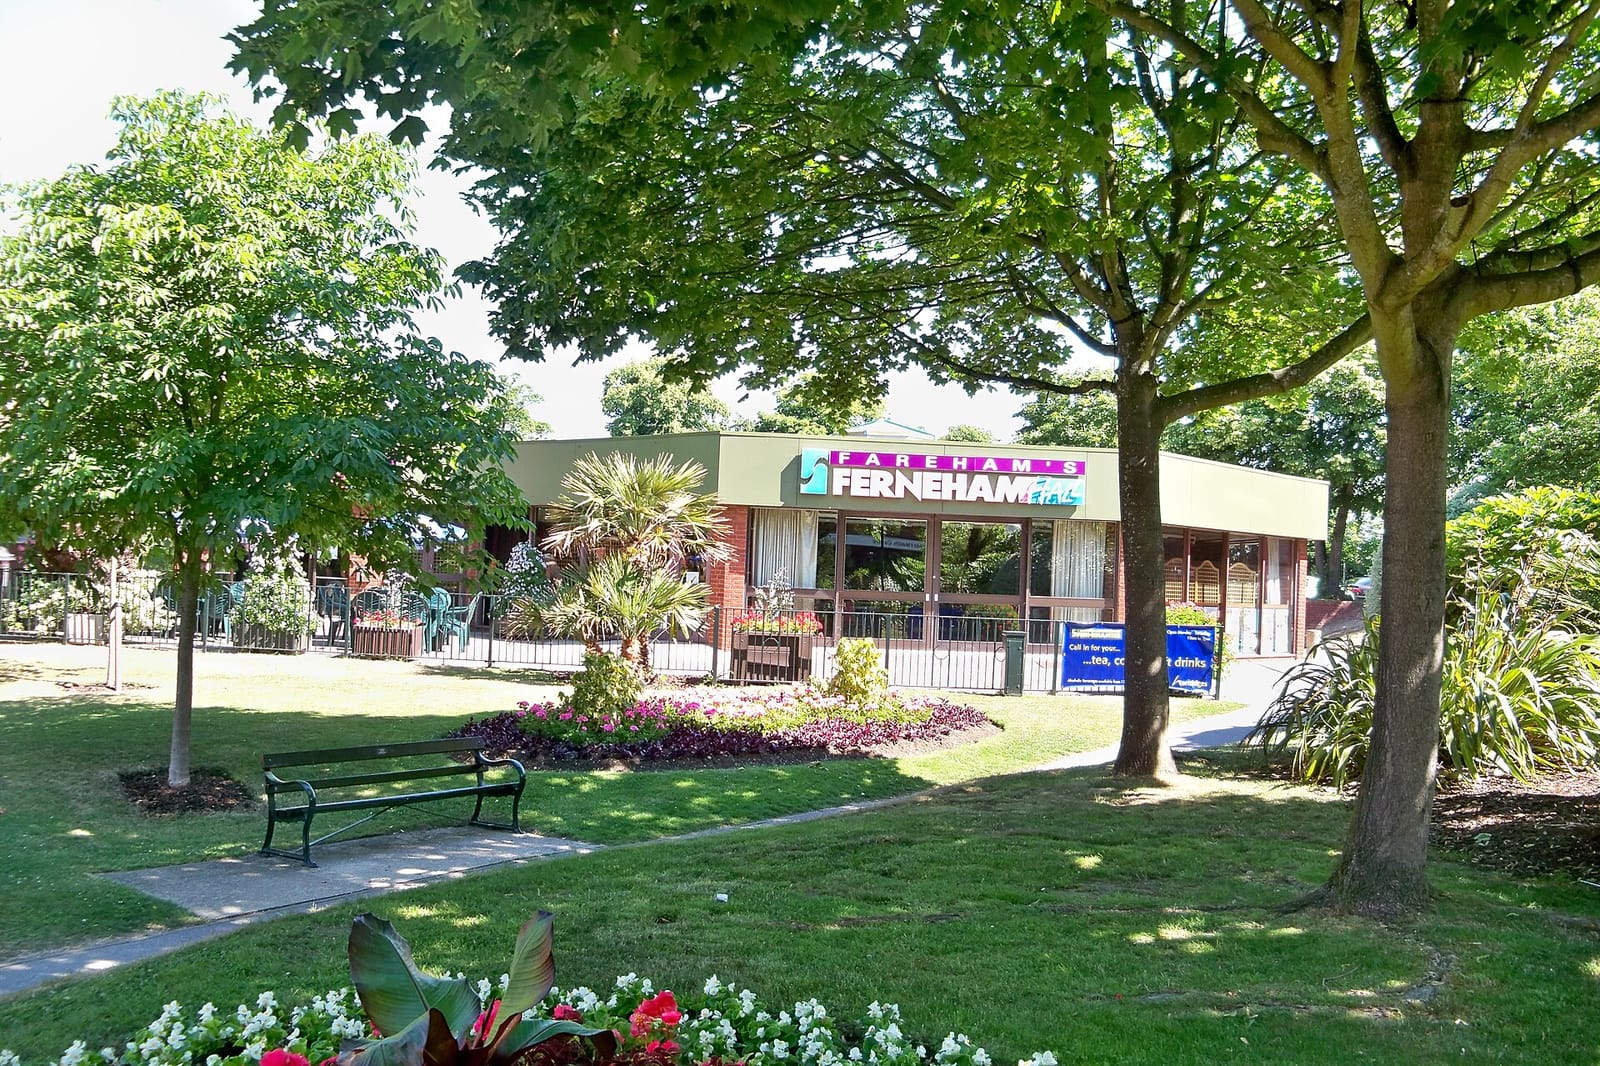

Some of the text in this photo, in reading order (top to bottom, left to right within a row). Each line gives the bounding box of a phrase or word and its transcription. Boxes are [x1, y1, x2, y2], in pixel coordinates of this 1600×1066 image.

[838, 452, 1078, 474] FAREHAM'S
[832, 468, 1034, 503] FERNEHAM
[1069, 643, 1081, 651] Call
[1174, 656, 1206, 668] drinks
